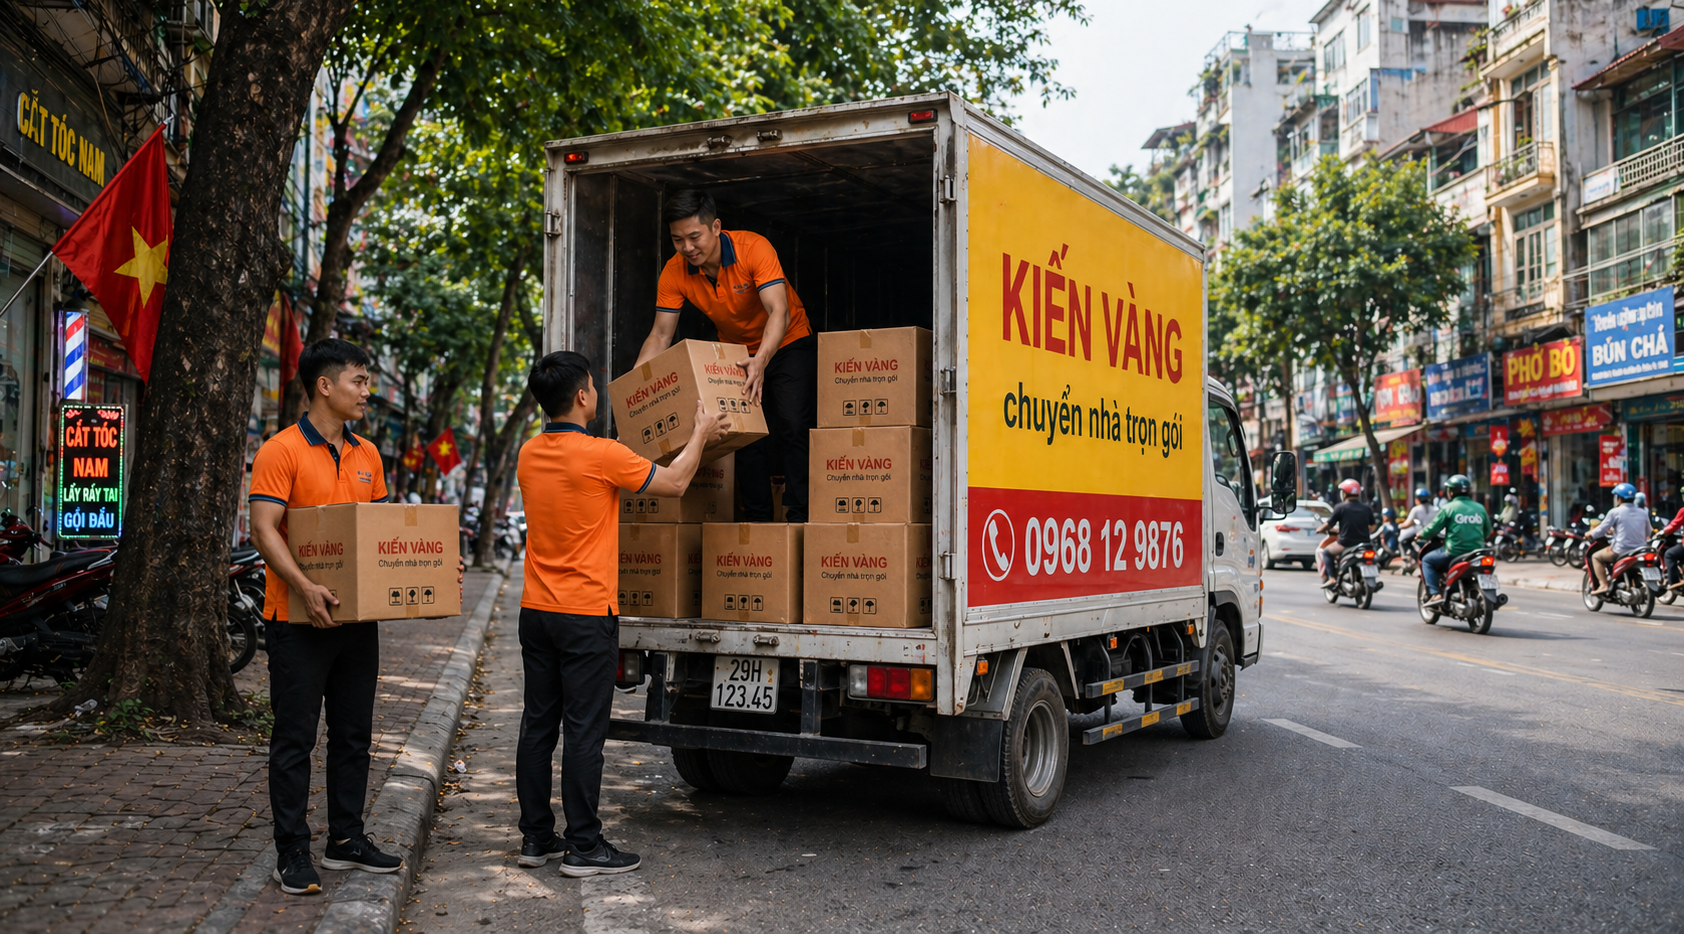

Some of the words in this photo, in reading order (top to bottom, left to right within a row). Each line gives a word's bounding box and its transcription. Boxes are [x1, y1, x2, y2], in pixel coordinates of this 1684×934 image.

[51, 114, 76, 167] TÓC
[79, 136, 105, 188] NAM
[1003, 243, 1091, 362] KIẾN
[1101, 281, 1183, 385] VÀNG
[835, 357, 862, 373] KIẾN
[865, 358, 898, 372] VÀNG
[626, 386, 649, 408] KIẾN
[650, 371, 678, 395] VÀNG
[1004, 382, 1082, 446] chuyển
[1089, 397, 1121, 442] nhà
[1126, 406, 1157, 455] trọn
[1162, 412, 1183, 458] gói
[93, 421, 117, 448] TÓC
[73, 457, 109, 478] NAM
[826, 455, 854, 470] KIẾN
[857, 456, 892, 470] VÀNG
[103, 487, 118, 502] TAI
[298, 540, 318, 557] KIẾN
[319, 540, 344, 556] VÀNG
[378, 537, 407, 555] KIẾN
[410, 538, 443, 555] VÀNG
[1025, 517, 1092, 576] 0968
[1100, 519, 1127, 572] 12
[1134, 519, 1184, 571] 9876
[634, 551, 661, 564] VÀNG
[717, 552, 741, 567] KIẾN
[743, 553, 772, 567] VÀNG
[821, 552, 849, 568] KIẾN
[852, 553, 887, 568] VÀNG
[729, 659, 762, 682] 29H
[717, 683, 773, 710] 123.45
